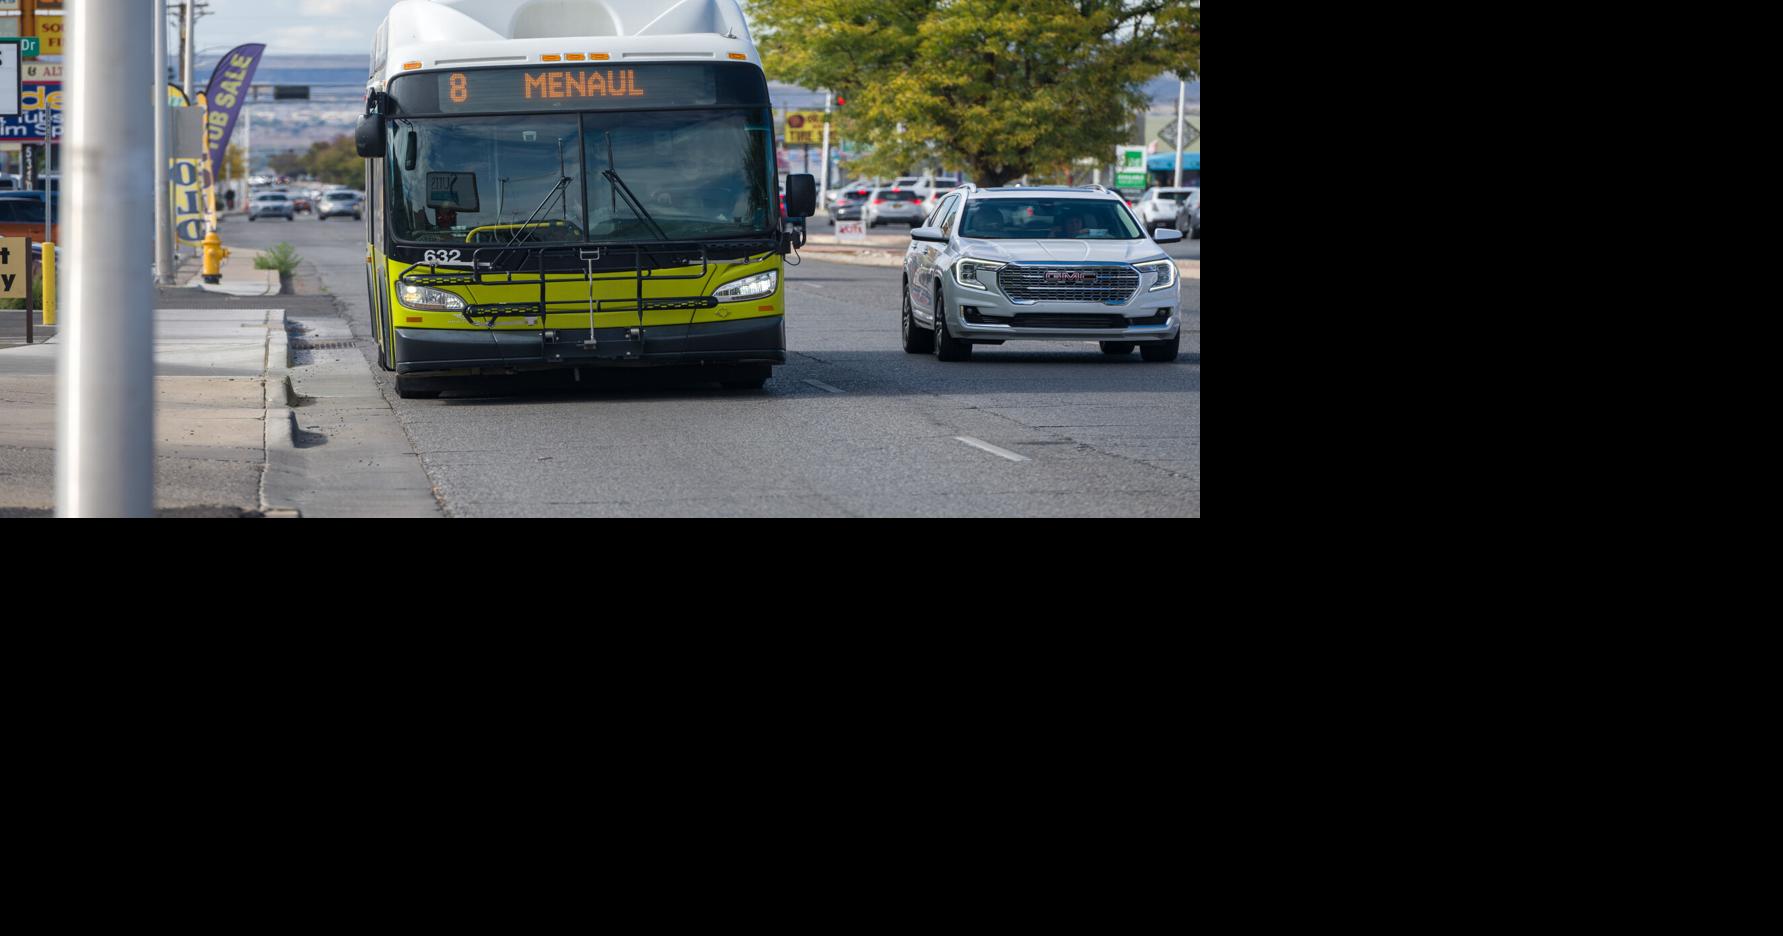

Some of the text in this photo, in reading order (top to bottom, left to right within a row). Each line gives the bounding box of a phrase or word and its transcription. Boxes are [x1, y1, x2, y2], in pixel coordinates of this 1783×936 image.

[42, 23, 64, 32] SO
[21, 38, 36, 51] Dr
[214, 53, 254, 109] SALE
[449, 69, 645, 103] 8 MENAUL
[424, 249, 461, 263] 632
[1044, 271, 1097, 281] GMC
